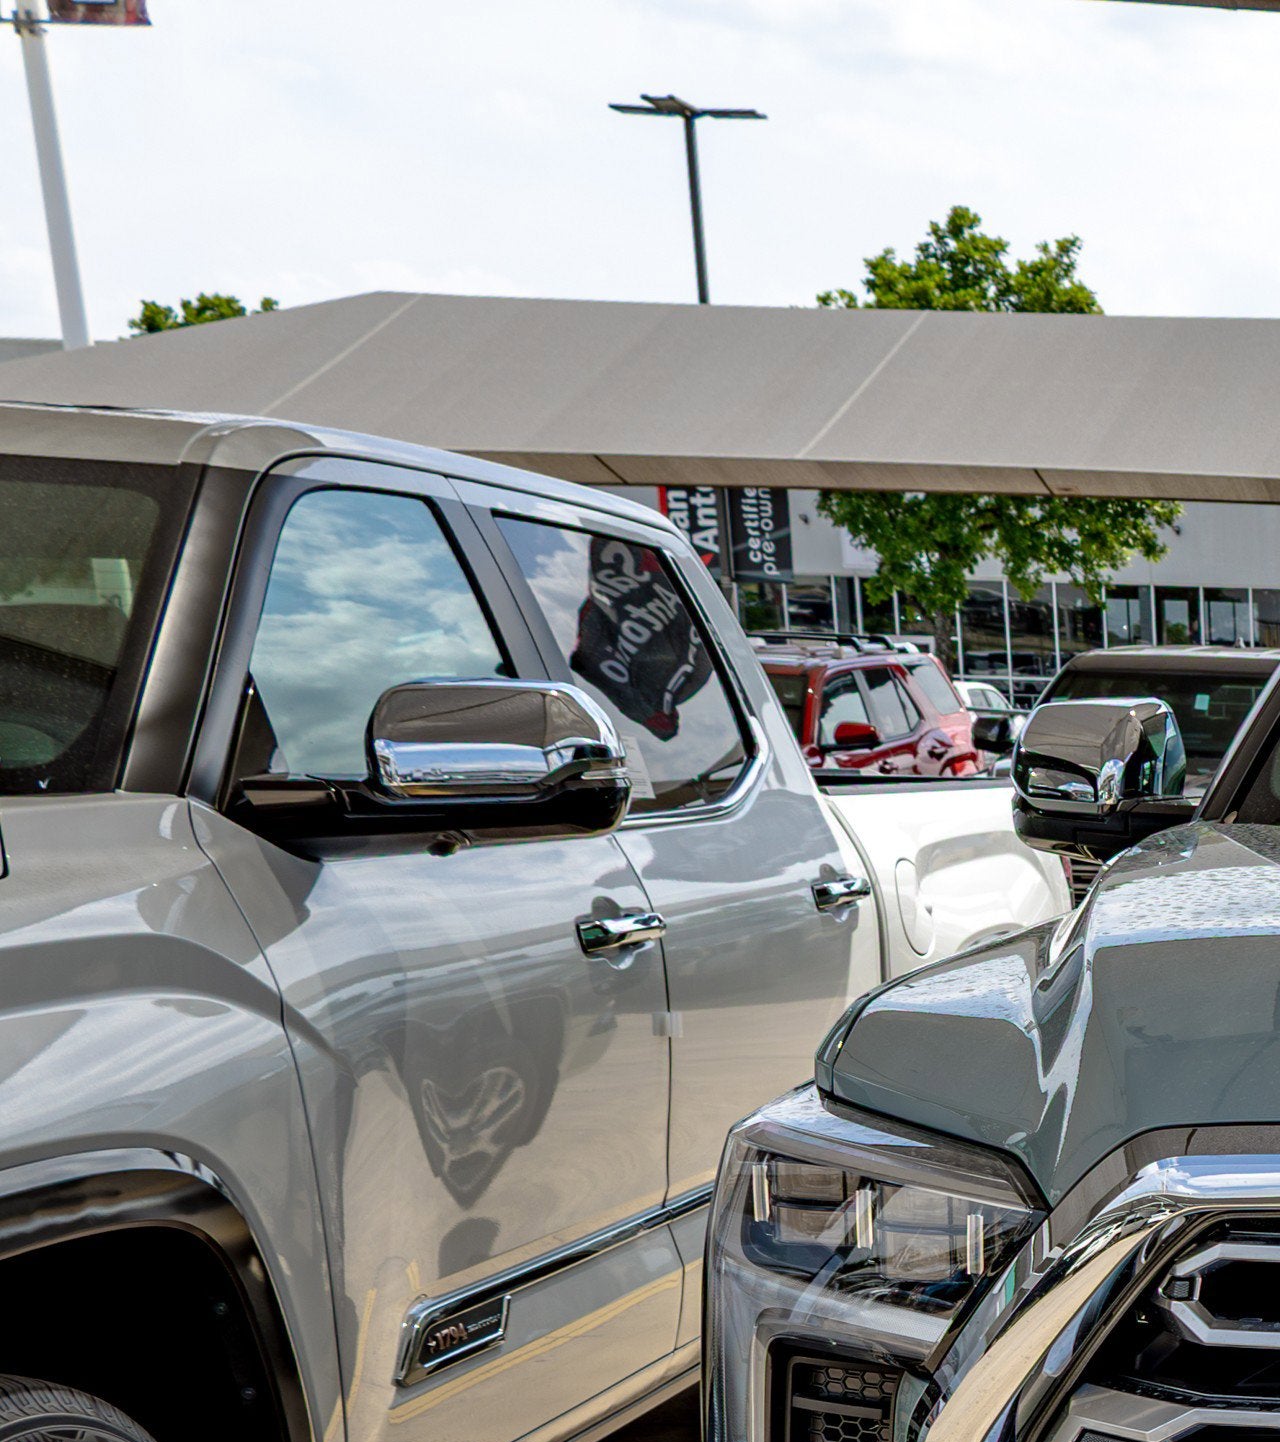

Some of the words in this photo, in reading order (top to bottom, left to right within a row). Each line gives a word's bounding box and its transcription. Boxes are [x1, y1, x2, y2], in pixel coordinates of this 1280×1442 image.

[667, 489, 691, 541] an
[741, 487, 762, 563] certifie
[758, 487, 780, 576] pre-own
